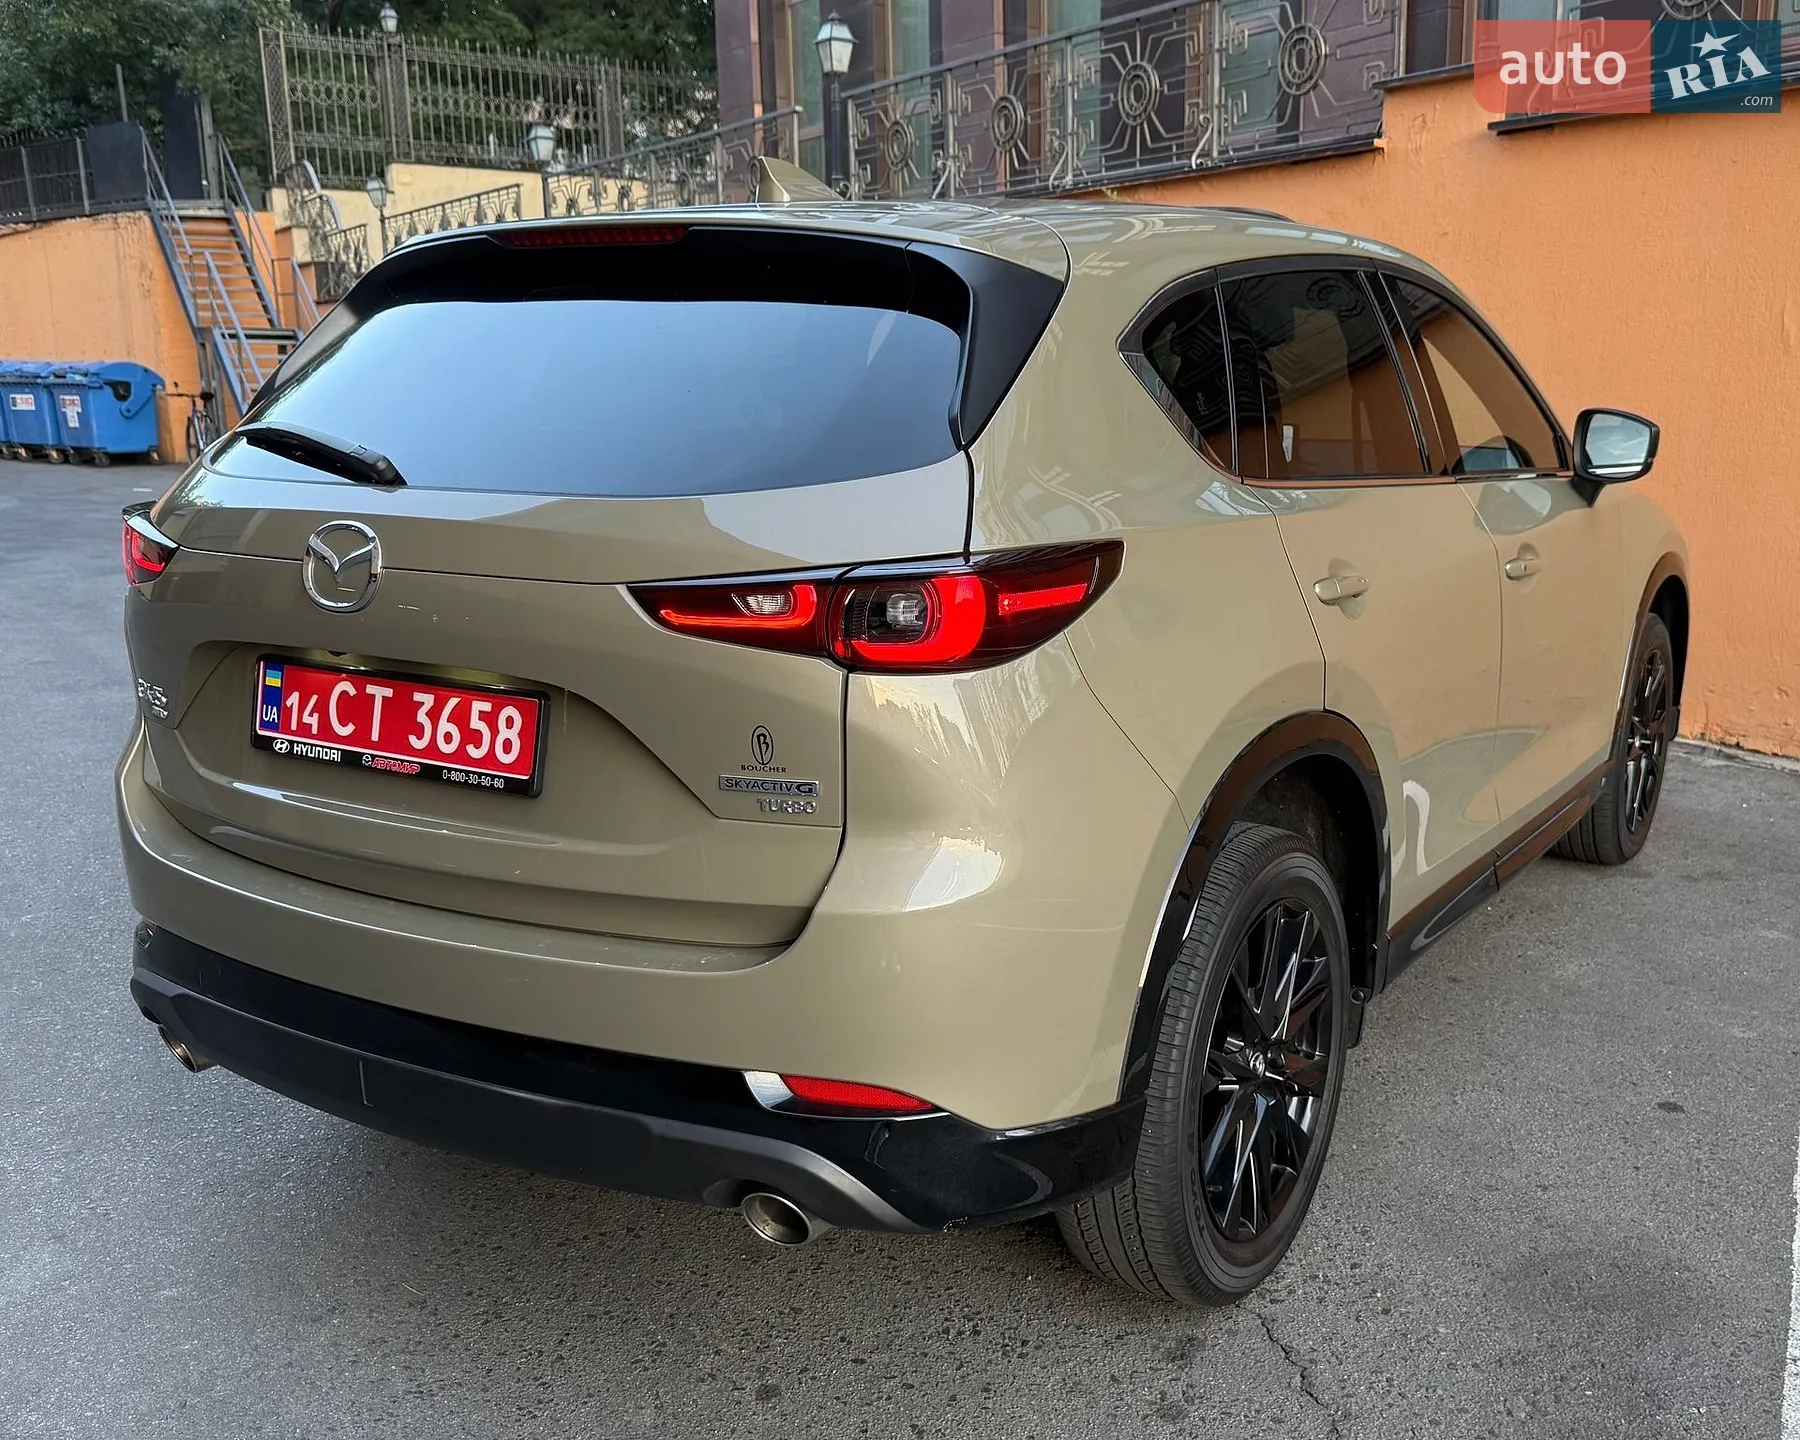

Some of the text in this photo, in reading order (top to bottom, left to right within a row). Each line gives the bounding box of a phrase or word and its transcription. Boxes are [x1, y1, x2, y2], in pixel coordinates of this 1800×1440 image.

[262, 704, 279, 723] UA
[408, 692, 523, 765] 3658
[293, 743, 341, 762] HYUNDAI
[372, 757, 420, 775] АВТОМИР
[740, 764, 787, 773] BOUCHER
[442, 769, 505, 788] 0-800-30-50-60
[757, 798, 818, 813] TURBO
